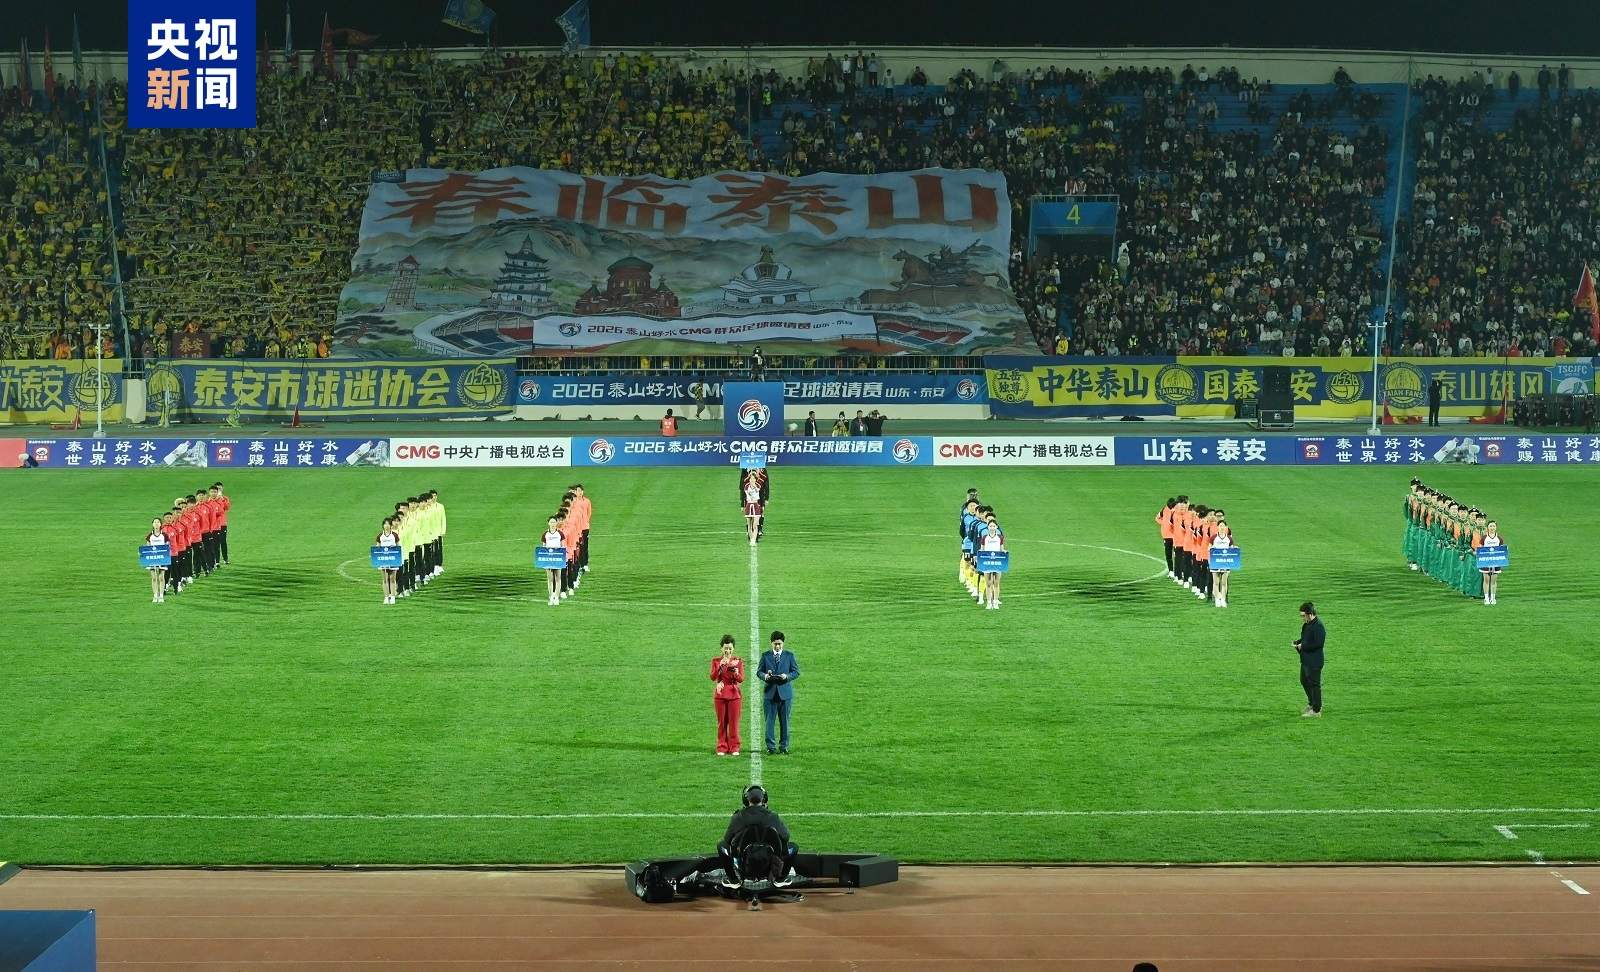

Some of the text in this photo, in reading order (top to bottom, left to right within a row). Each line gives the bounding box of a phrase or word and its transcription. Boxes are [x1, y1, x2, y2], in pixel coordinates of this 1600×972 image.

[373, 170, 999, 236] 春临泰山
[1066, 204, 1080, 225] 4
[587, 325, 623, 334] 2026
[1558, 364, 1588, 375] TSCJFC
[193, 367, 450, 409] 泰安市球迷协会
[552, 383, 605, 398] 2026
[607, 382, 684, 398] 泰山好水
[1037, 367, 1149, 403] 中华泰山
[1203, 368, 1318, 402] 国泰安
[65, 440, 157, 452] 泰山好水
[248, 440, 339, 452] 泰山好水
[624, 440, 884, 453] 2026 泰山好水 CMG 群众足球邀请赛
[1335, 437, 1425, 449] 泰山好水
[396, 445, 565, 460] CMG 中央广播电视总台
[939, 444, 1108, 458] CMG 中央广播电视总台
[1143, 438, 1267, 462] 山东·泰安
[1335, 450, 1426, 463] 世界好水
[65, 453, 156, 466] 世界好水
[247, 453, 338, 466] 赐福健康
